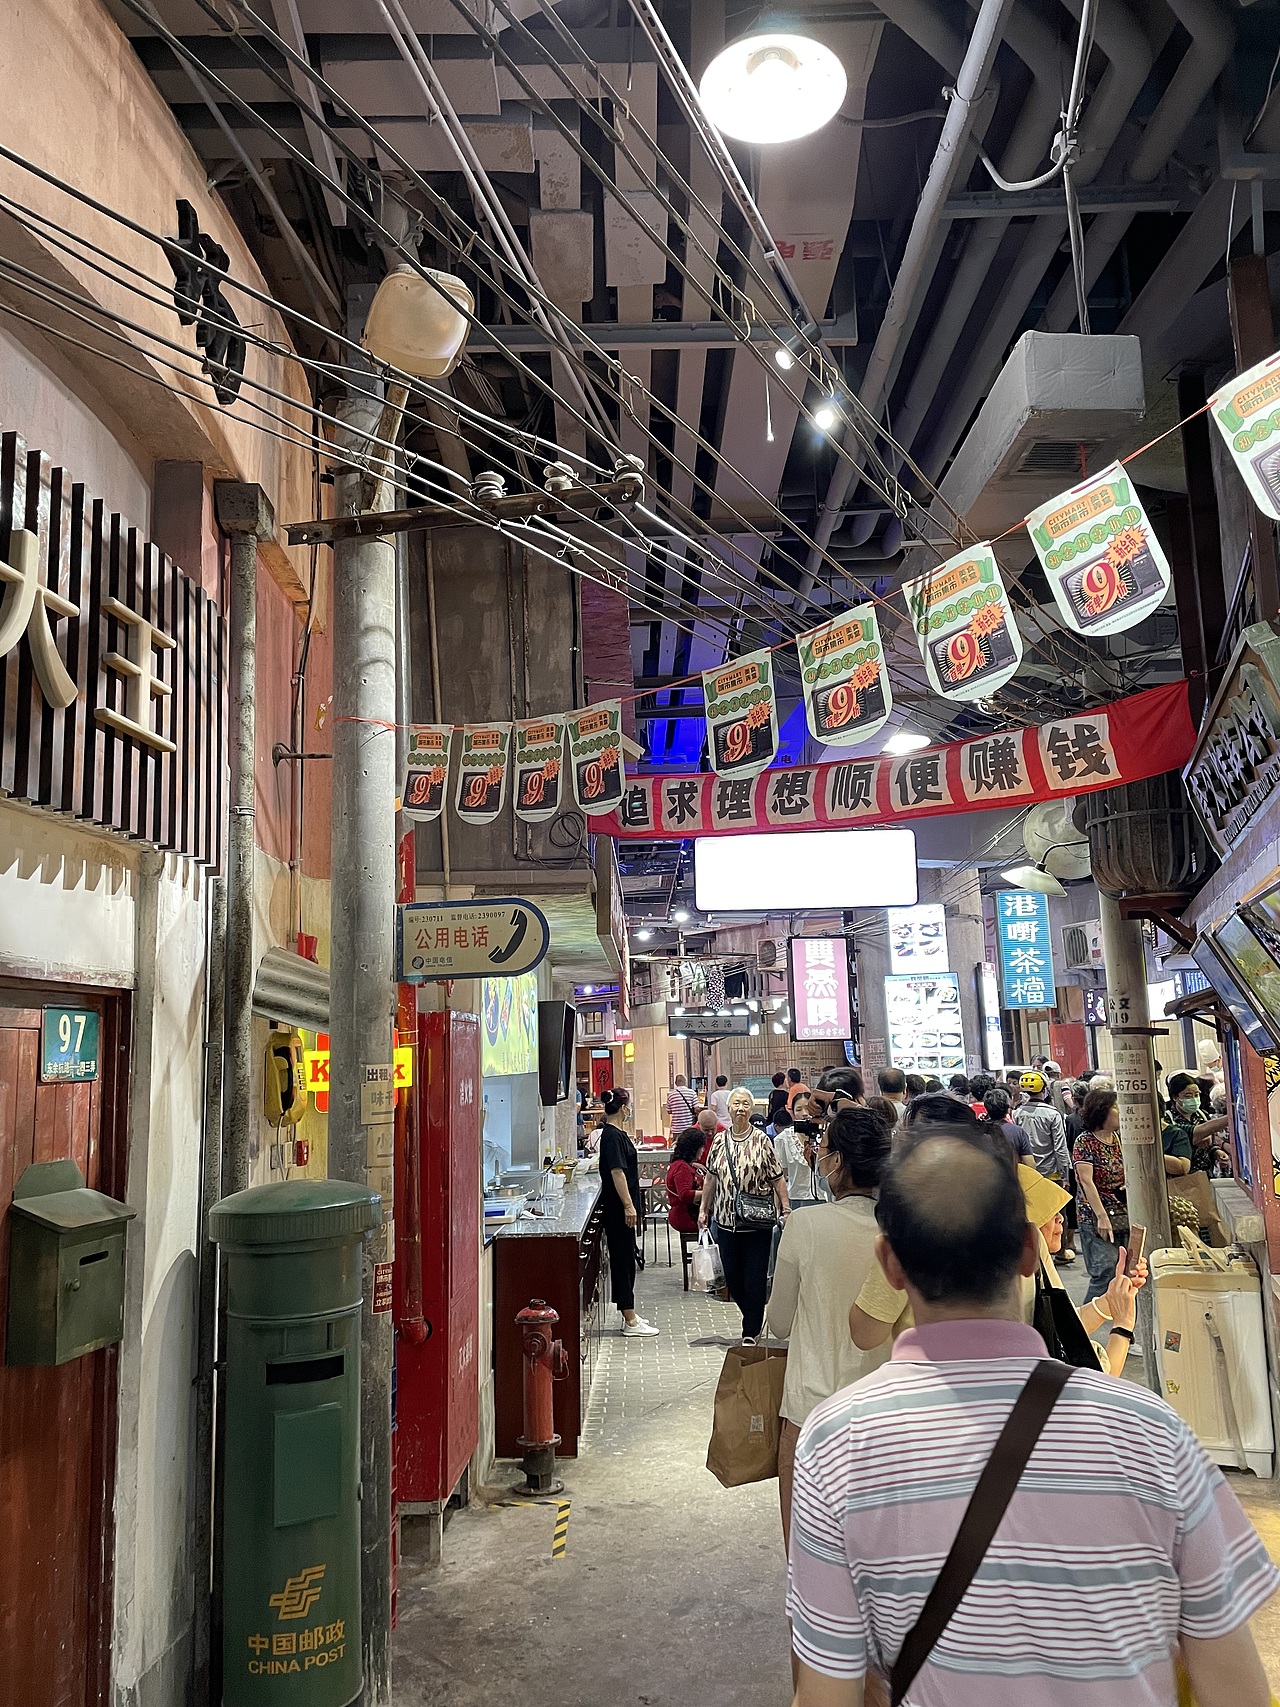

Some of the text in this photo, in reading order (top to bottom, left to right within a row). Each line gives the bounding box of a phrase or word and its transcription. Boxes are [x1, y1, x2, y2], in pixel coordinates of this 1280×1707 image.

[1048, 501, 1087, 526] CITYMART
[925, 574, 955, 595] CITYMART
[1086, 562, 1118, 615] 9
[814, 631, 843, 647] CITYMART
[951, 633, 977, 678] 9
[717, 671, 742, 685] CITYMART
[831, 685, 854, 726] 9
[730, 724, 748, 759] 9
[414, 775, 431, 805] 9
[470, 776, 487, 807] 9
[526, 772, 544, 805] 9
[586, 763, 603, 797] 9
[618, 723, 1110, 829] 追求理想顺便赚钱
[414, 925, 489, 950] 公用电话
[1004, 895, 1046, 1004] 港嘢茶檔
[425, 956, 453, 964] 中国电信
[59, 1014, 87, 1053] 97
[684, 1018, 733, 1028] 东大名路
[310, 1059, 330, 1082] K
[248, 1619, 345, 1656] 中国邮政
[248, 1643, 346, 1674] CHINA POST
